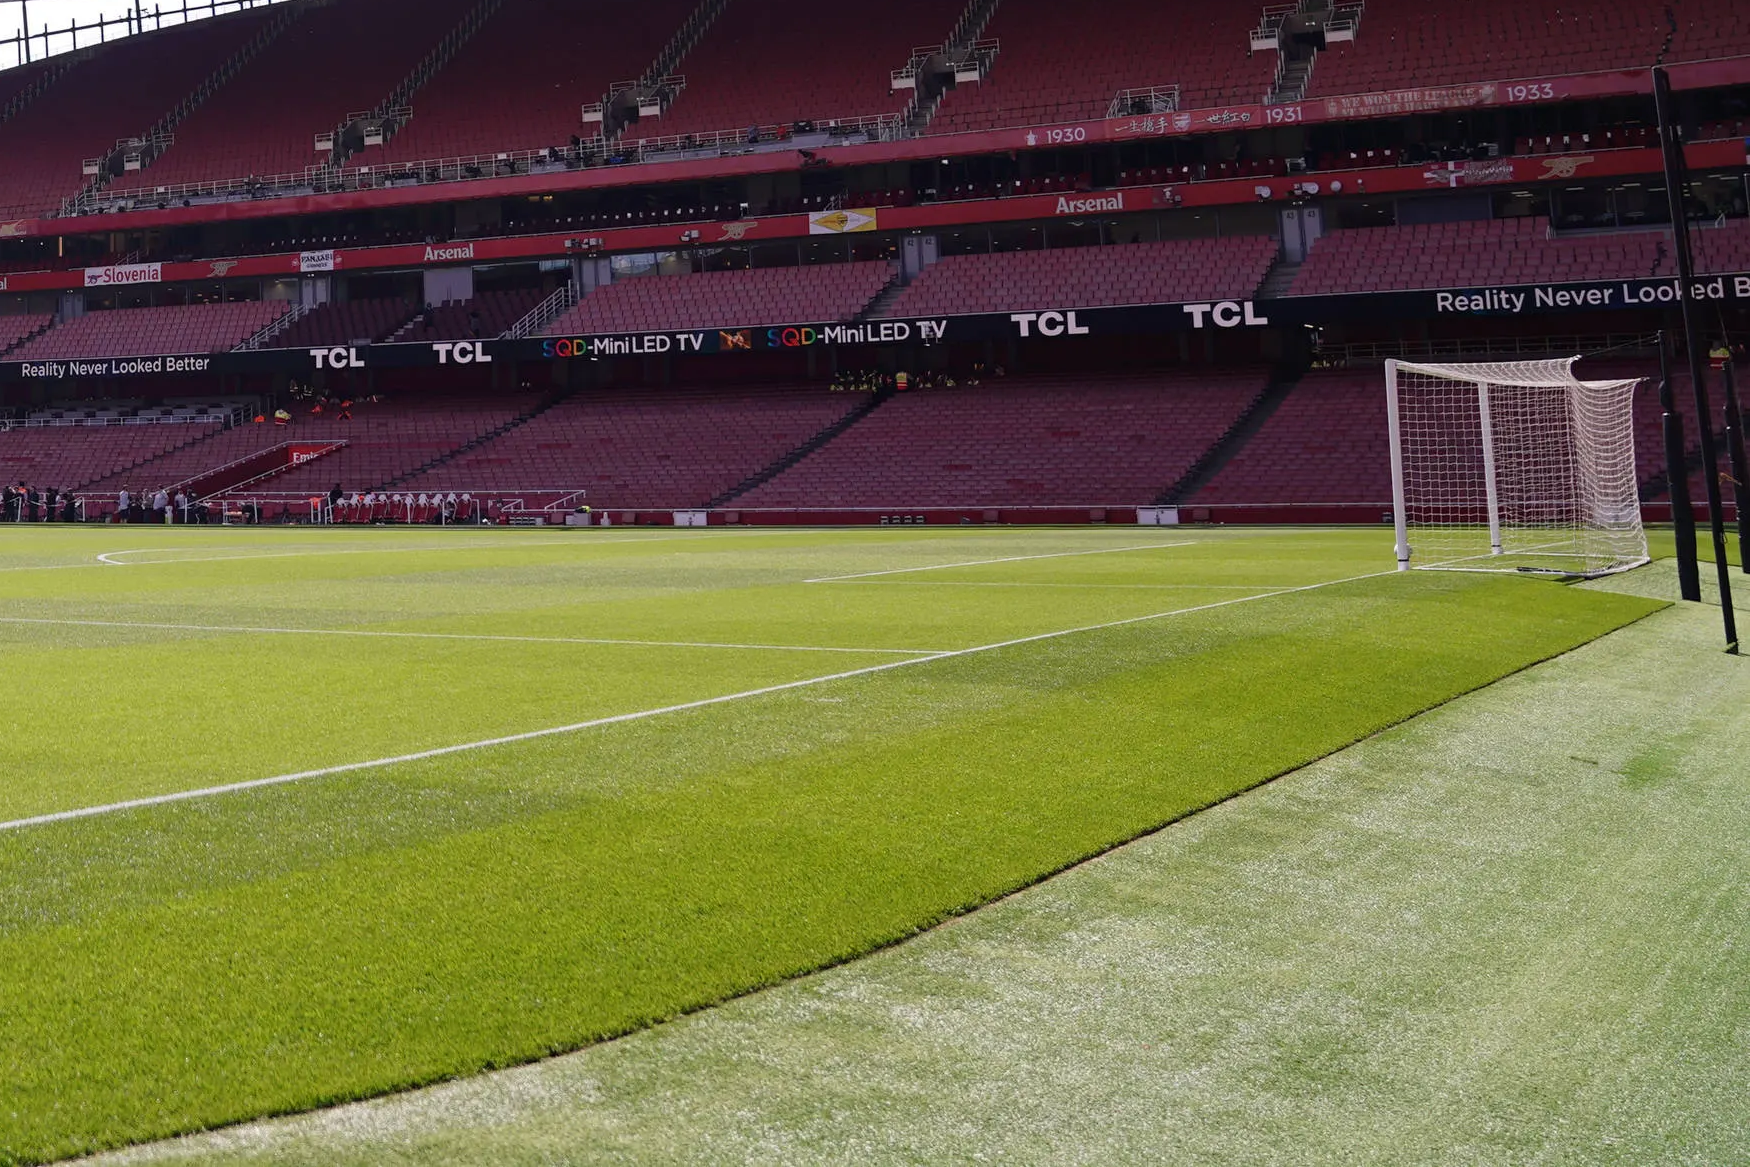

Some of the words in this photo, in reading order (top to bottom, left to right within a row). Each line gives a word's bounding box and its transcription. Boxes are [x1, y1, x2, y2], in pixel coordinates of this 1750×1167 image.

[1341, 97, 1360, 108] WE
[1363, 94, 1391, 106] WON
[1393, 91, 1420, 102] THE
[1424, 88, 1476, 101] LEAGUE
[1506, 83, 1553, 101] 1933
[1266, 106, 1303, 124] 1931
[1046, 127, 1086, 144] 1930
[1055, 192, 1123, 214] Arsenal
[424, 243, 474, 261] Arsenal
[103, 268, 159, 283] Slovenia
[1436, 288, 1524, 313] Reality
[1534, 287, 1613, 307] Never
[1010, 311, 1089, 337] TCL
[1183, 301, 1268, 328] TCL
[916, 320, 947, 339] TV
[676, 333, 704, 351] TV
[310, 347, 365, 369] TCL
[433, 342, 492, 364] TCL
[21, 362, 65, 378] Reality
[69, 361, 108, 376] Never
[111, 357, 162, 374] Looked
[166, 356, 210, 372] Better
